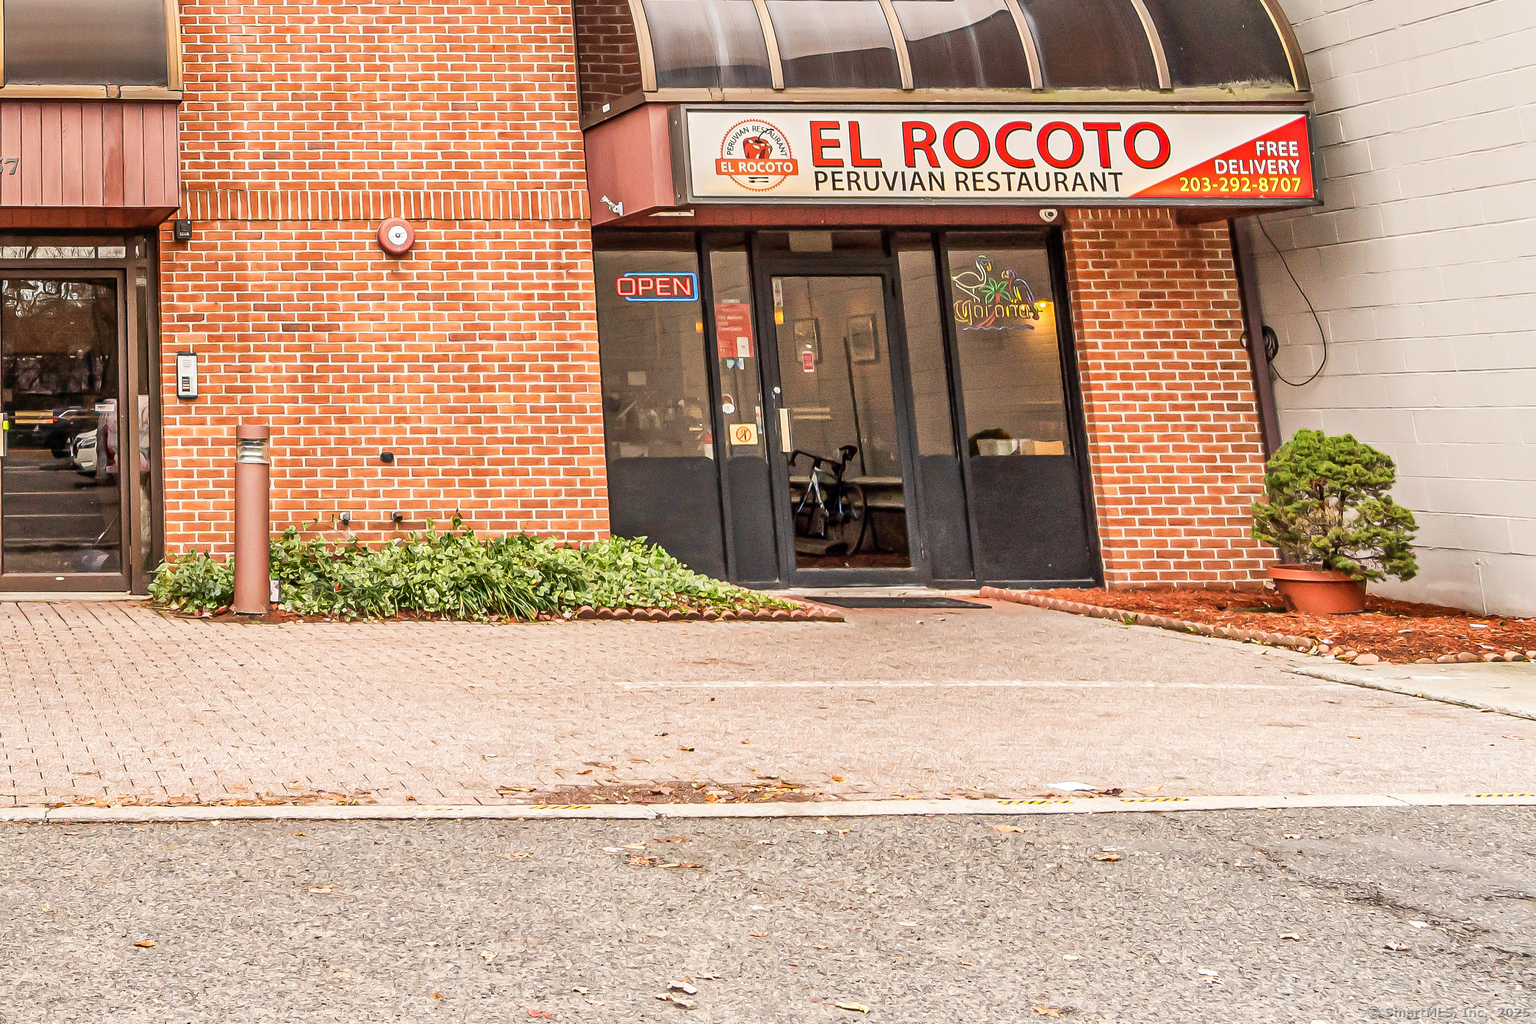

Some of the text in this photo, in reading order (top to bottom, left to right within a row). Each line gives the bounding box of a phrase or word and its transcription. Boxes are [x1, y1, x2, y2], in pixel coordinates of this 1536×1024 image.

[726, 125, 788, 157] PERUVIAN RESTAURANT
[809, 120, 1172, 170] EL ROCOTO
[1255, 140, 1300, 157] FREE
[720, 161, 794, 173] EL ROCOTO
[1214, 159, 1301, 175] DELIVERY
[814, 170, 1123, 193] PERUVIAN RESTAURANT
[1179, 176, 1302, 193] 203-292-8707
[616, 277, 692, 296] OPEN
